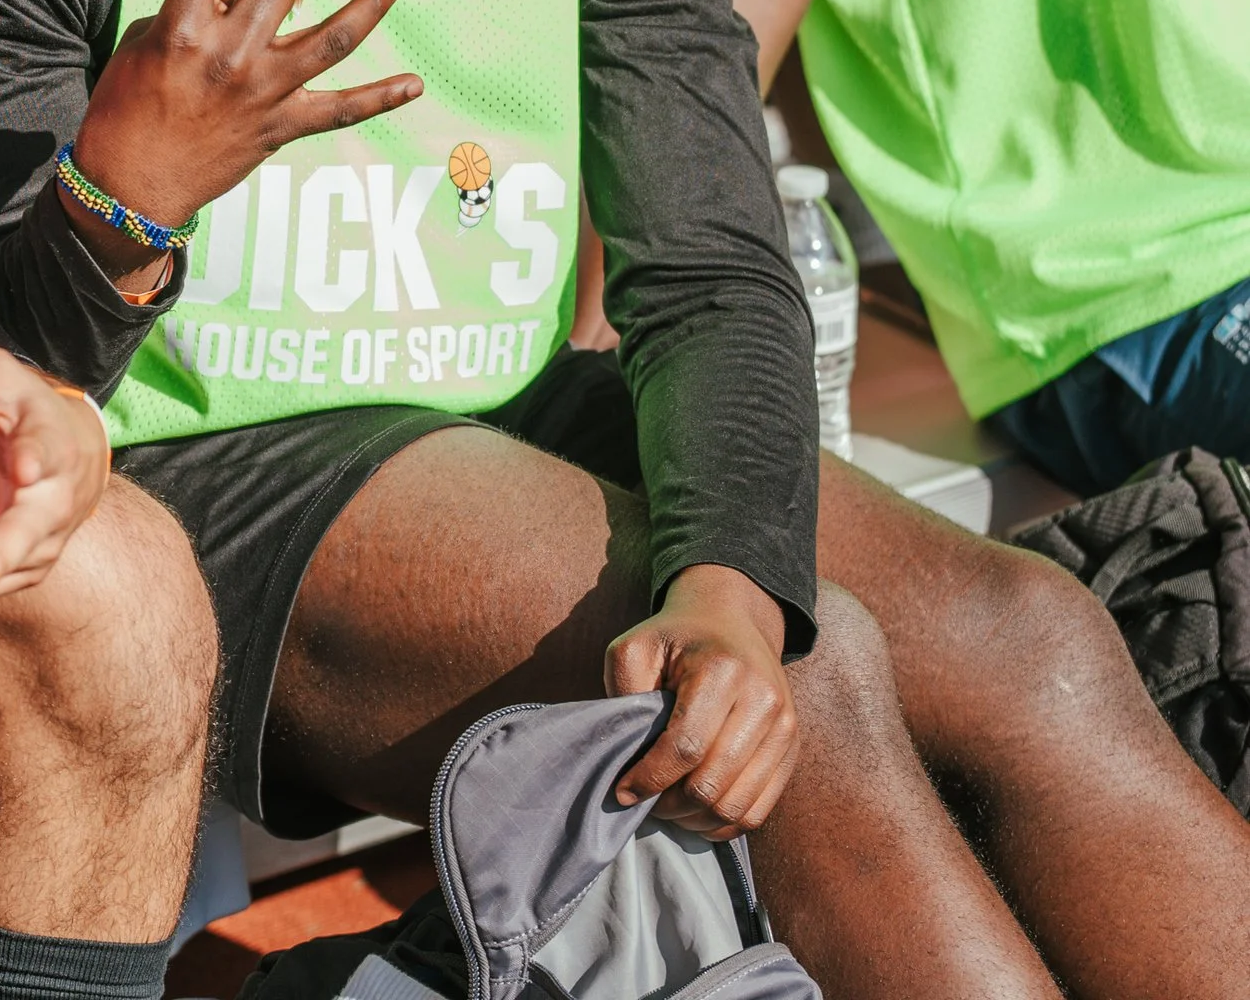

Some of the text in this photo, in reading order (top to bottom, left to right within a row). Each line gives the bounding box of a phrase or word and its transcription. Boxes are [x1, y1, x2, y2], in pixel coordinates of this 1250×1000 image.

[165, 316, 541, 385] HOUSE OF SPORT
